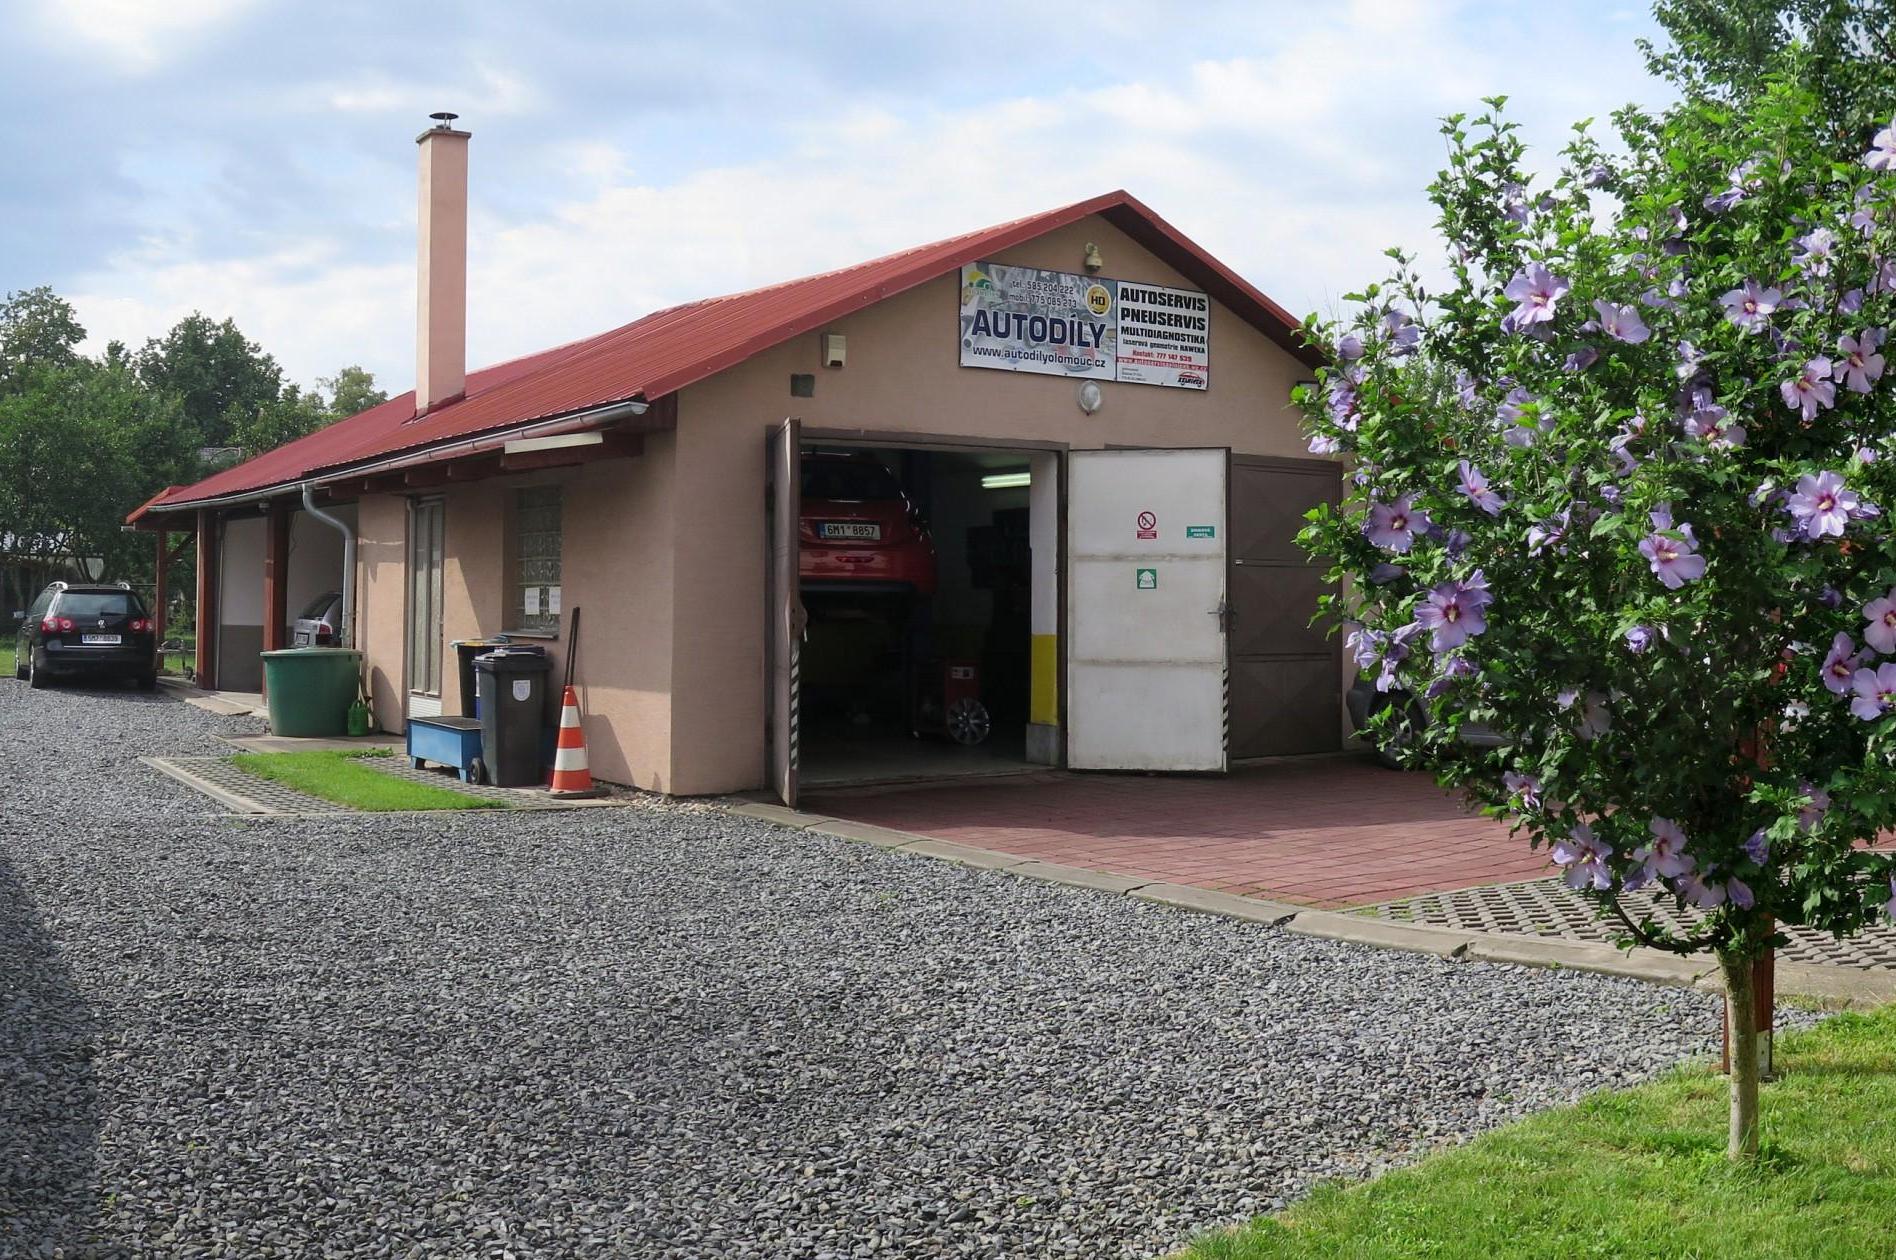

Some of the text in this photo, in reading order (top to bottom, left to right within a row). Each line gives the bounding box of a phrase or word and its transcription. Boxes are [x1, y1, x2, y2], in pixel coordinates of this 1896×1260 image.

[1027, 281, 1041, 291] 585
[1043, 283, 1058, 293] 204
[1060, 285, 1074, 295] 222
[1031, 295, 1046, 304] 775
[1047, 297, 1061, 306] 085
[1063, 299, 1077, 308] 273
[1091, 295, 1105, 306] HD
[1120, 287, 1206, 312] AUTOSERVIS
[1120, 307, 1206, 331] PNEUSERVIS
[971, 309, 1107, 349] AUTODÍLY
[1121, 326, 1206, 345] MULTIDIAGNOSTIKA
[972, 346, 1106, 368] www.autodilyolomouc.cz
[853, 526, 875, 536] 8857
